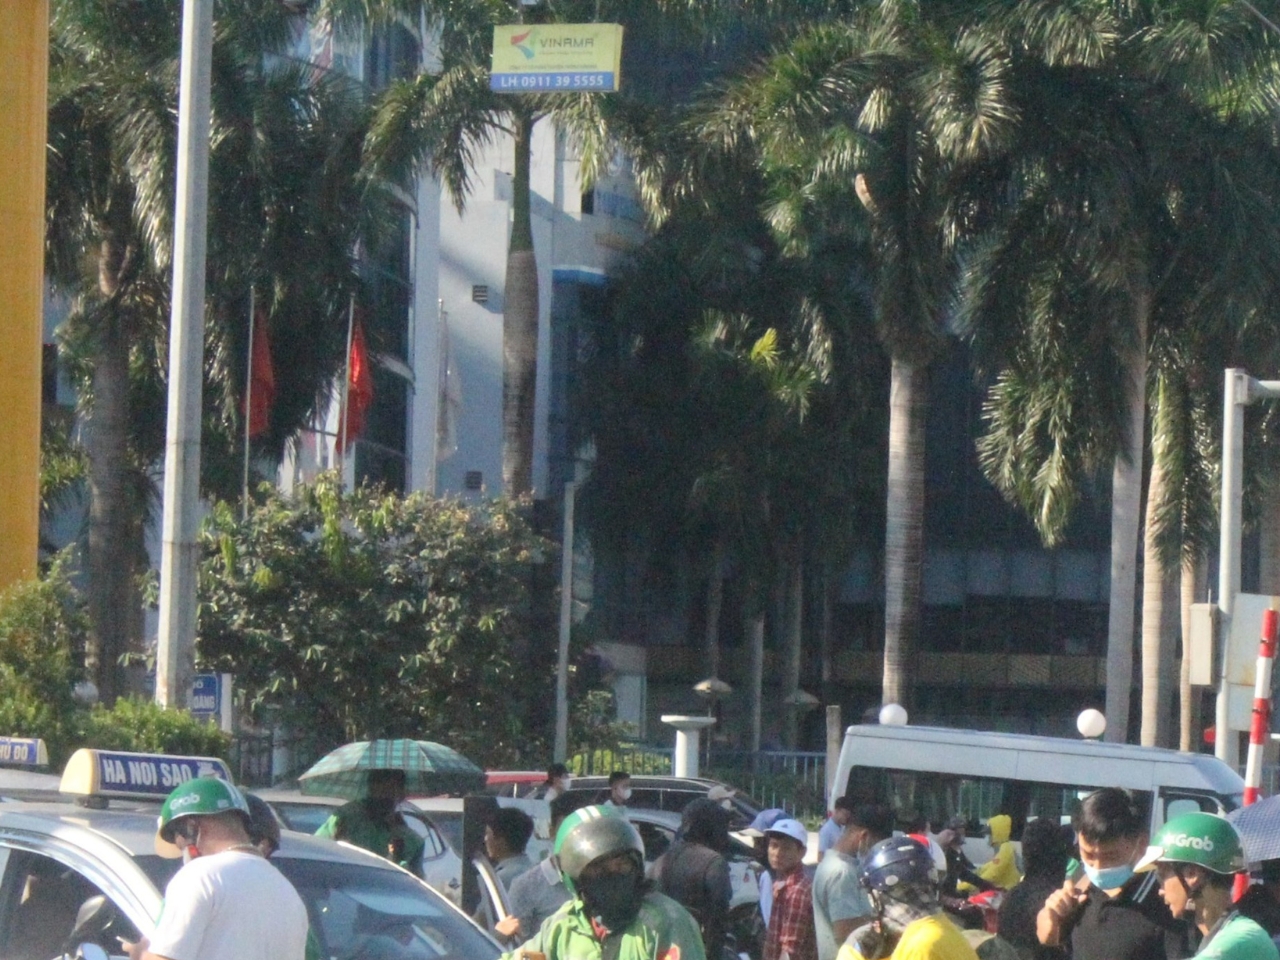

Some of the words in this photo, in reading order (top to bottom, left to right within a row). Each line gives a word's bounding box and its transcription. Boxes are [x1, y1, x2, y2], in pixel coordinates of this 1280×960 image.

[501, 76, 518, 88] LH
[521, 76, 551, 88] 0911
[555, 75, 571, 87] 39
[573, 75, 604, 87] 5555
[169, 792, 200, 811] Grab
[1174, 833, 1214, 852] Grab
